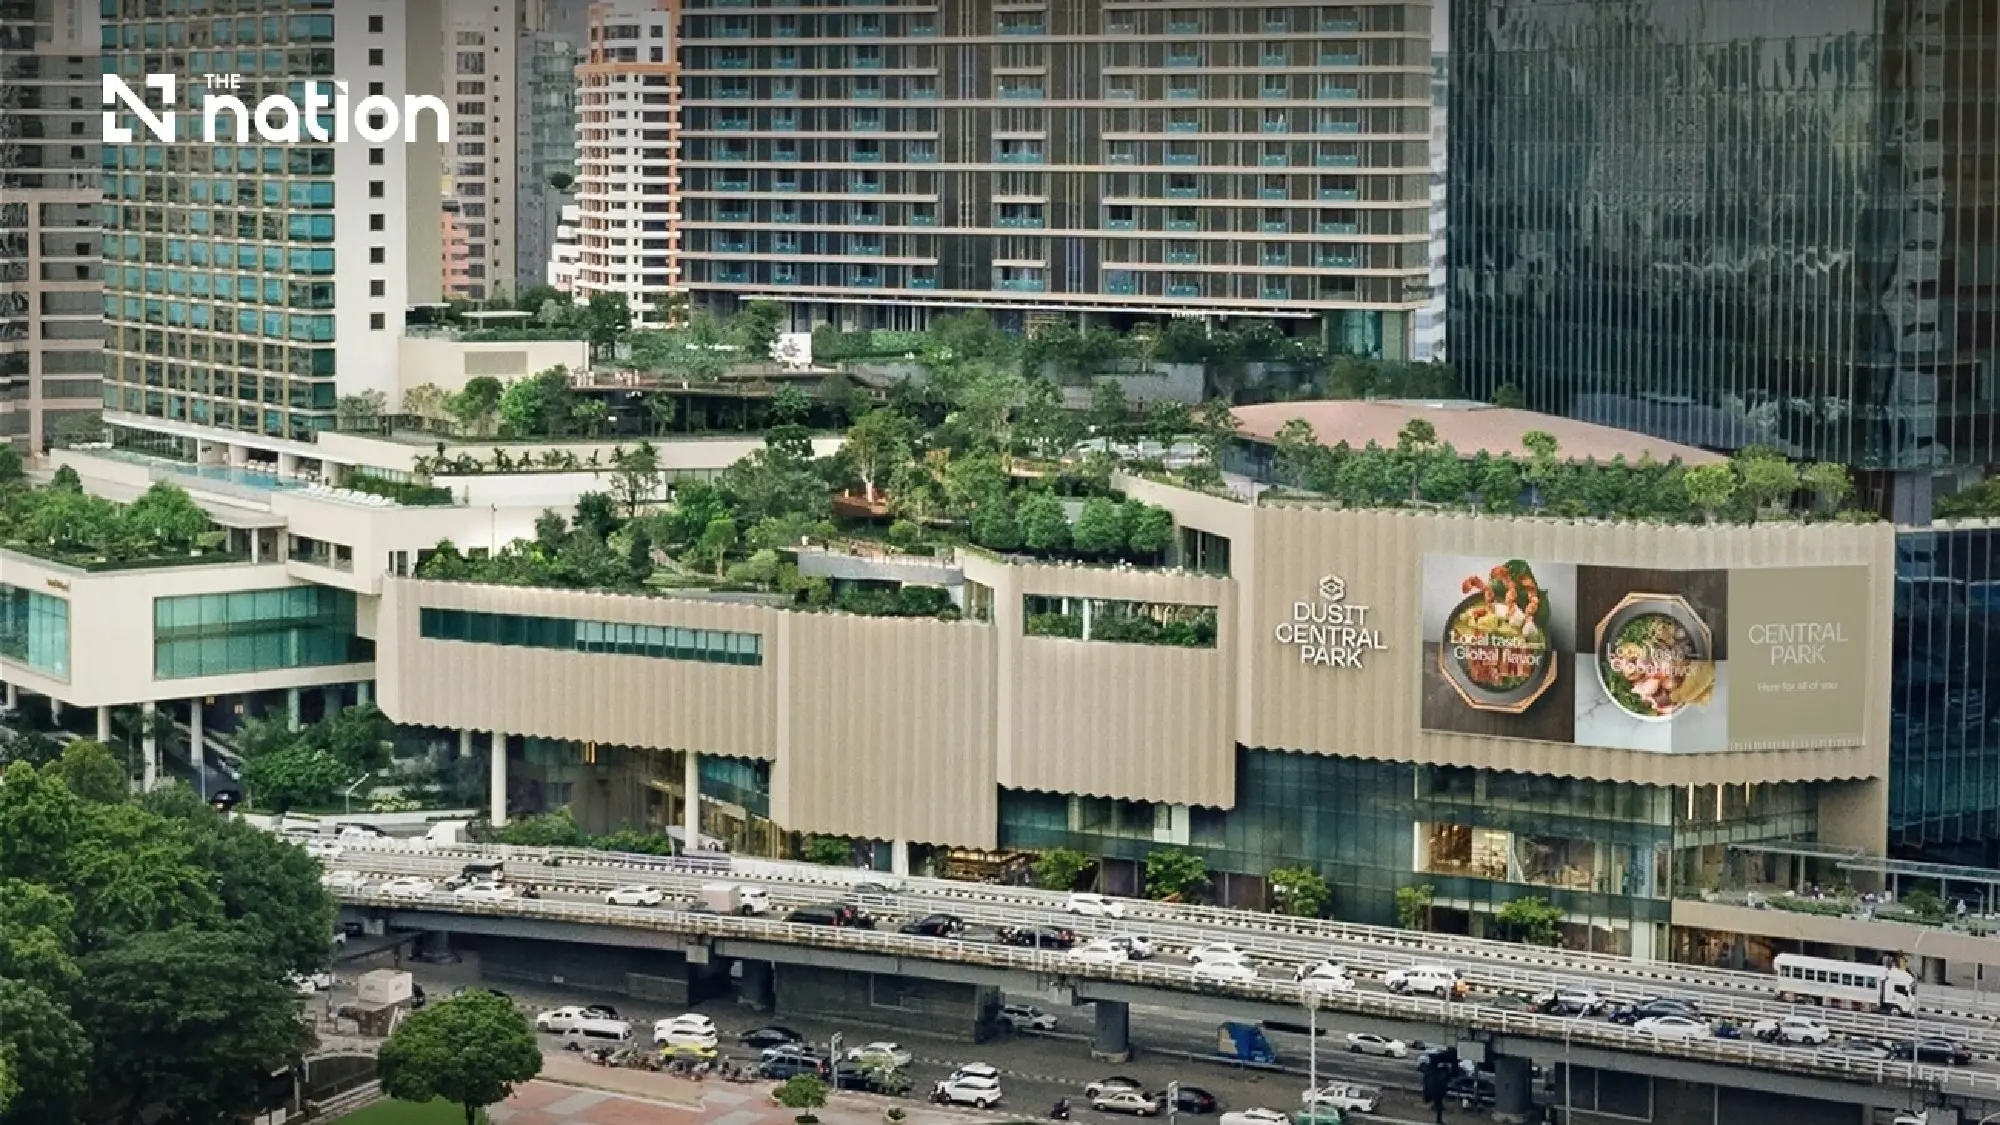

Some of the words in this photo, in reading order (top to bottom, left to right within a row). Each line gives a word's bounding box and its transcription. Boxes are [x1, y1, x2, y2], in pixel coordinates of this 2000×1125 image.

[1293, 601, 1370, 626] DUSIT
[1275, 622, 1389, 650] CENTRAL
[1450, 630, 1489, 646] Local
[1748, 622, 1849, 645] CENTRAL
[1301, 645, 1364, 669] PARK
[1454, 645, 1499, 661] Global
[1502, 648, 1542, 666] flavor
[1771, 644, 1826, 666] PARK
